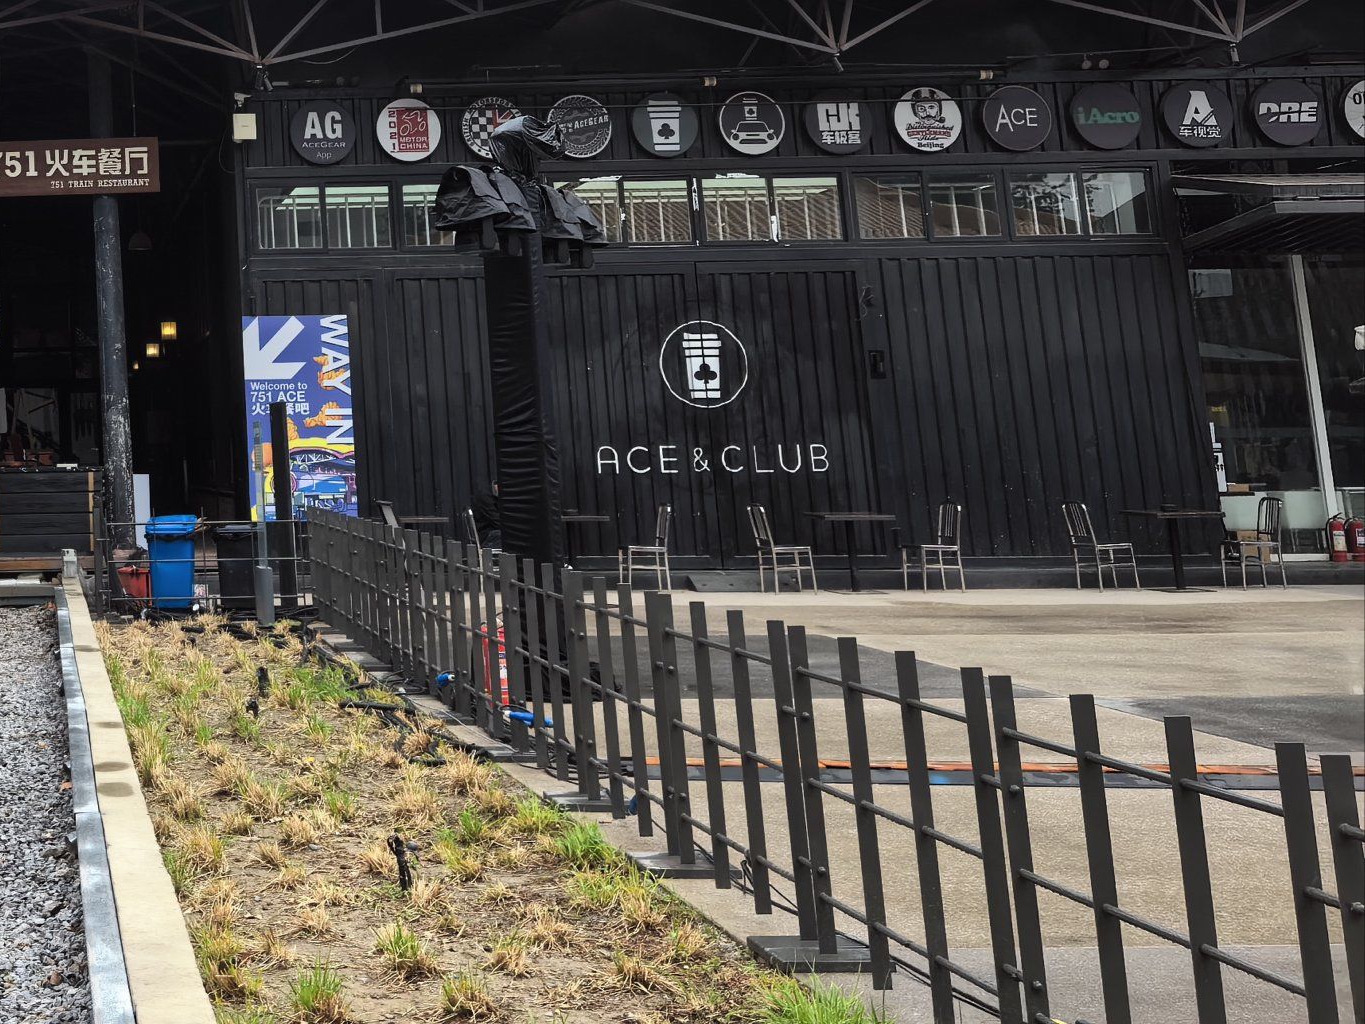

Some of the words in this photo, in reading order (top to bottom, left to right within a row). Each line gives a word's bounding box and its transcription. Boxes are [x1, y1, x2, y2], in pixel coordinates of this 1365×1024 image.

[303, 110, 343, 140] AG
[995, 104, 1038, 132] ACE
[1179, 126, 1222, 138] 车视觉
[316, 151, 333, 160] App
[50, 181, 64, 189] 751
[68, 180, 94, 188] TRAIN
[98, 178, 150, 187] RESTAURANT
[320, 315, 352, 396] WAY
[250, 381, 295, 390] Welcome
[298, 382, 308, 390] to
[250, 391, 272, 403] 751
[277, 391, 306, 402] ACE
[325, 408, 355, 444] IN
[597, 445, 679, 474] ACE
[693, 447, 711, 472] &
[721, 444, 829, 473] CLUB
